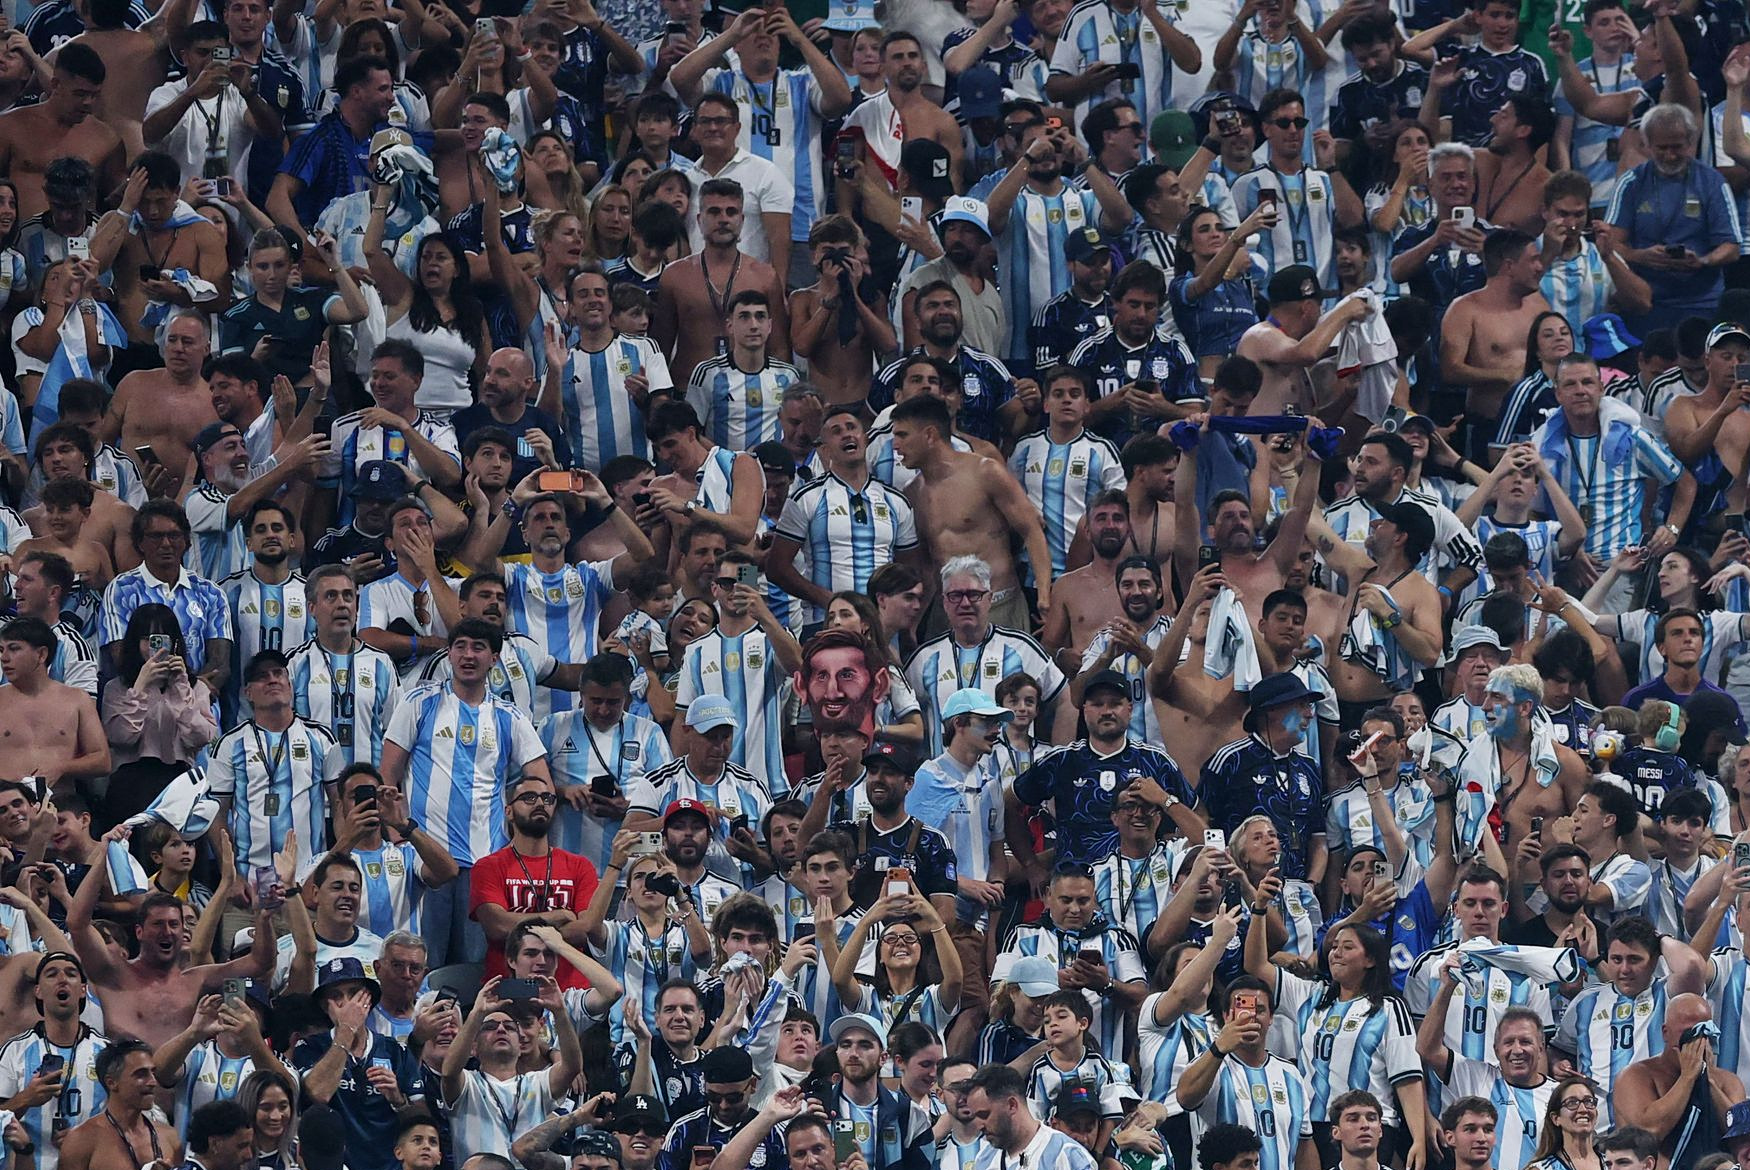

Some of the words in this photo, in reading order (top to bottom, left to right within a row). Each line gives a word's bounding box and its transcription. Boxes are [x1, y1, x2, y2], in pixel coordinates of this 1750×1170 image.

[751, 112, 771, 136] 10
[259, 626, 284, 651] 10
[1637, 766, 1663, 780] MESSI
[1632, 785, 1665, 811] 10
[1463, 1003, 1488, 1034] 10
[1313, 1031, 1336, 1061] 10
[1610, 1023, 1635, 1051] 10
[1253, 1108, 1276, 1138] 10
